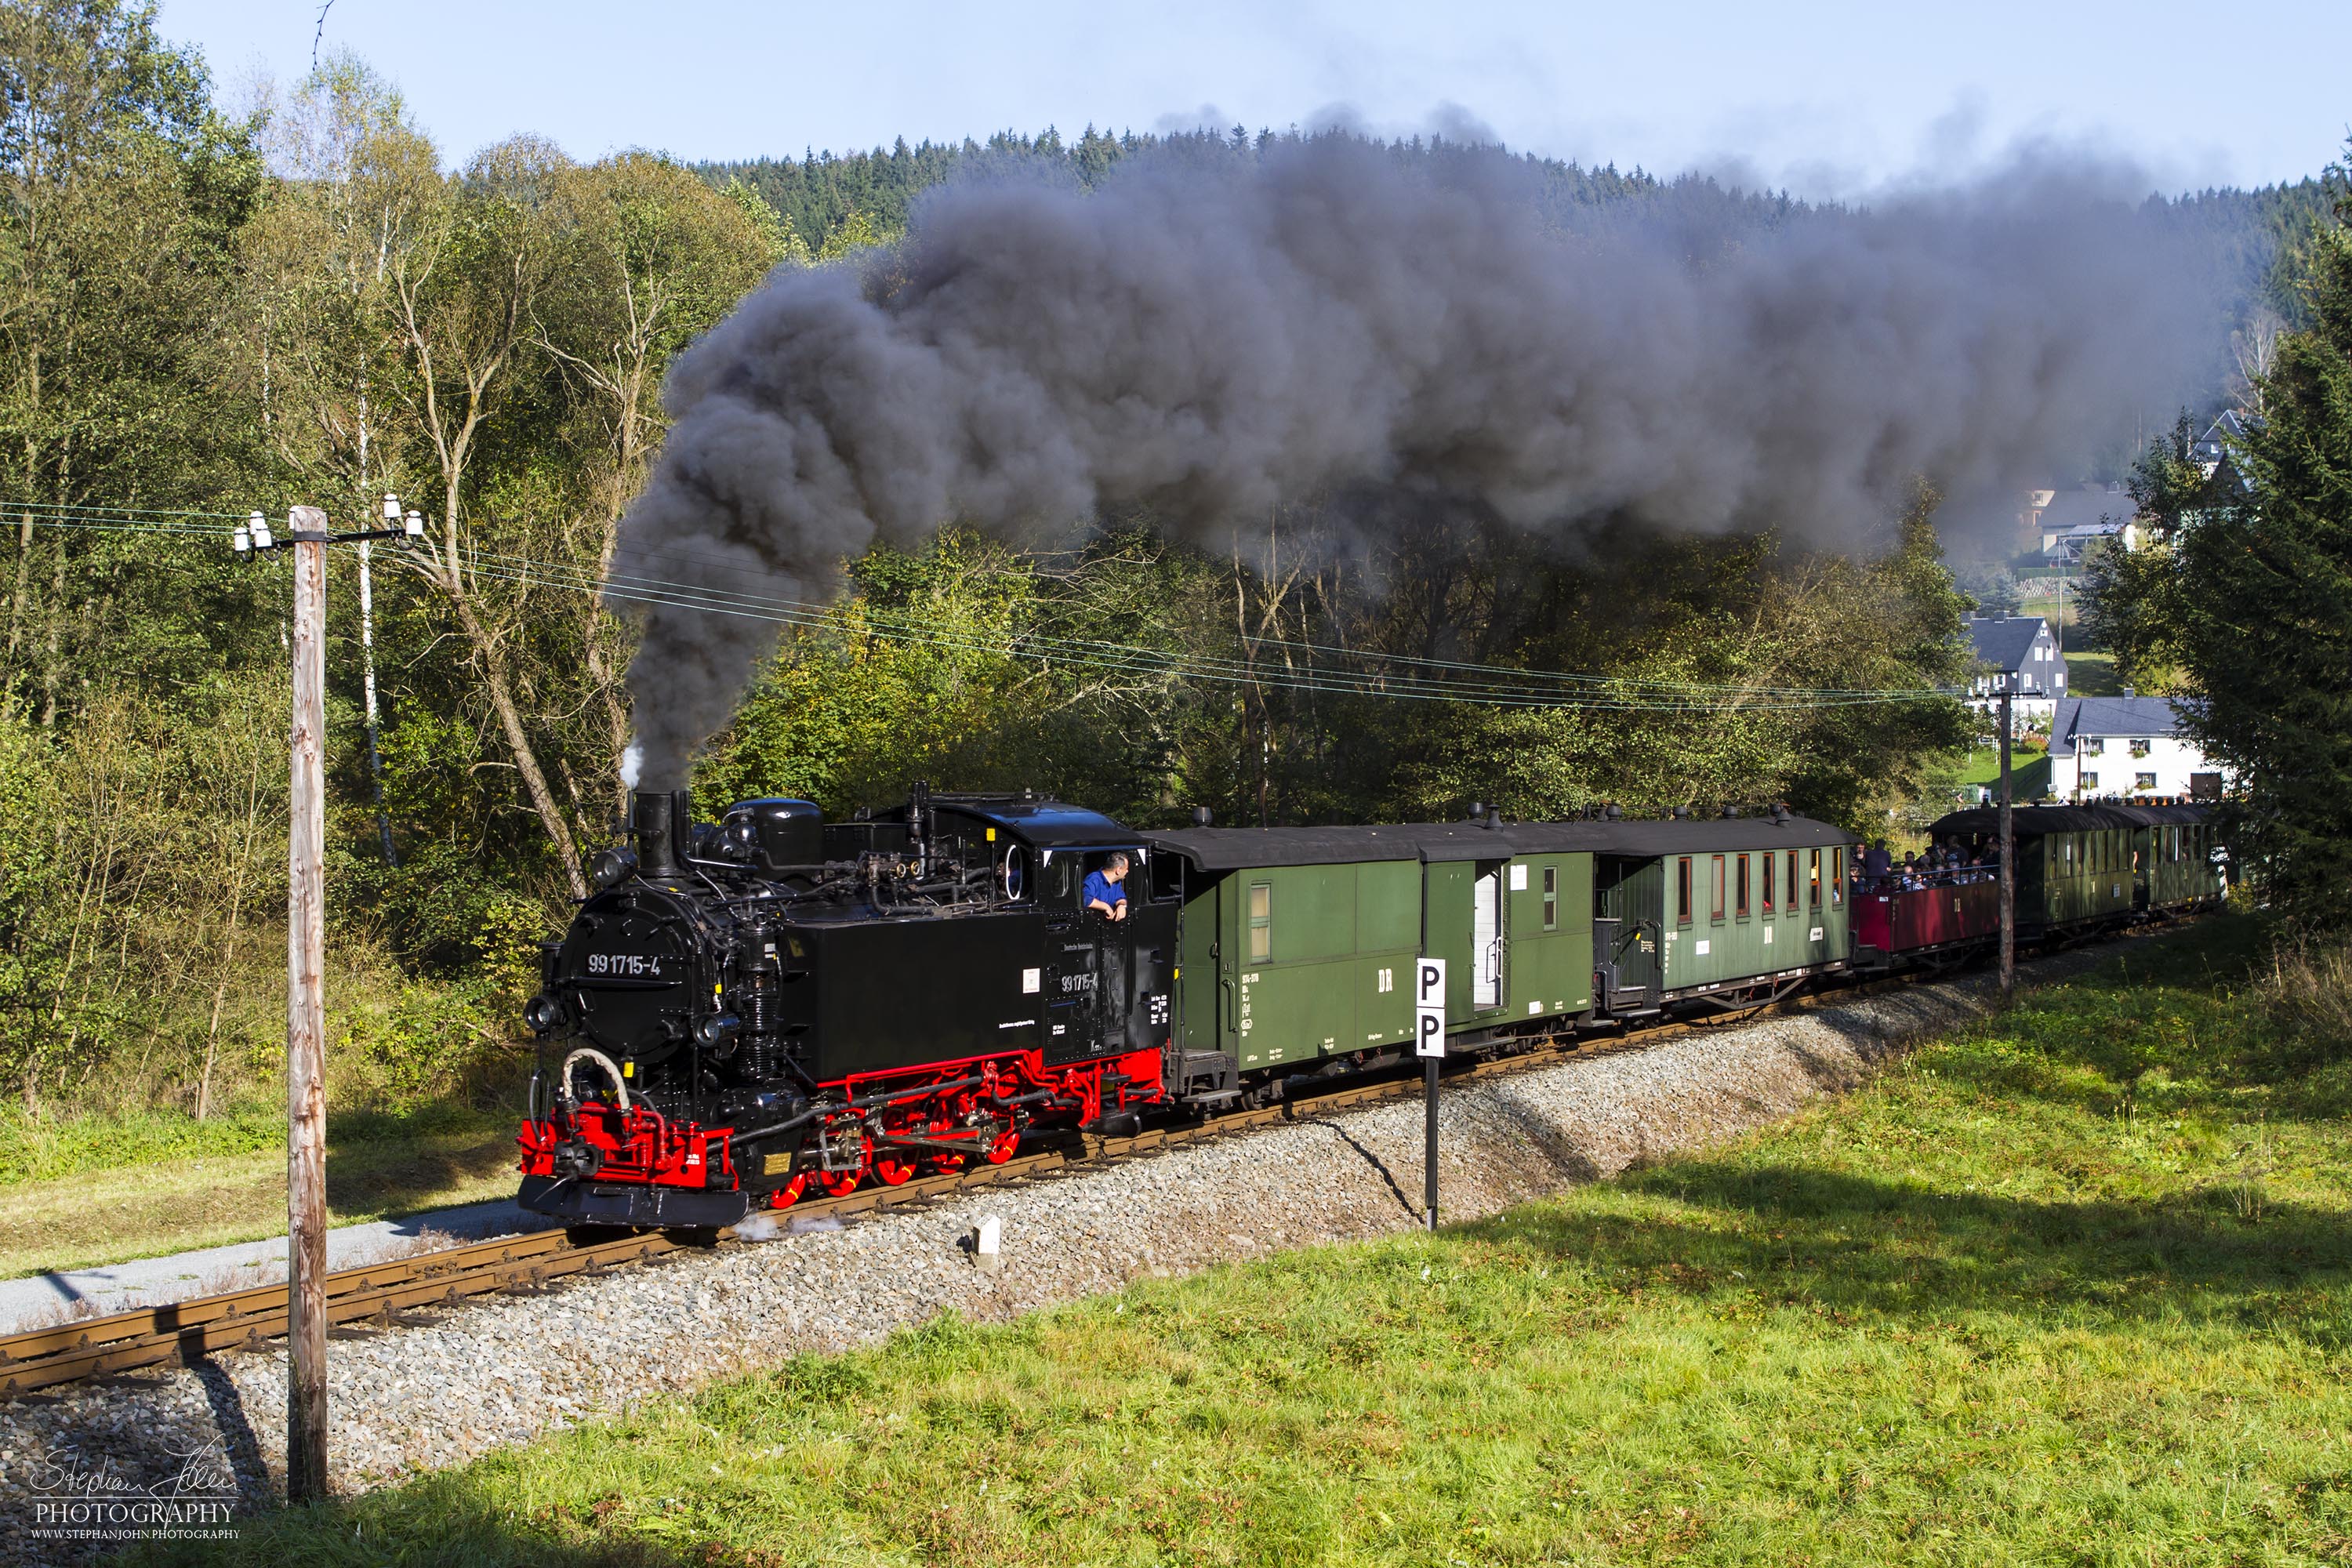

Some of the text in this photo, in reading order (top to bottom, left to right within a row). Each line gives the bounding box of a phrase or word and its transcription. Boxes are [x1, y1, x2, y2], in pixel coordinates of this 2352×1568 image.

[589, 954, 660, 975] 99 1715-4
[1062, 975, 1073, 992] 99
[1378, 968, 1392, 993] DR
[1421, 966, 1440, 1000] P
[1421, 1015, 1439, 1050] P
